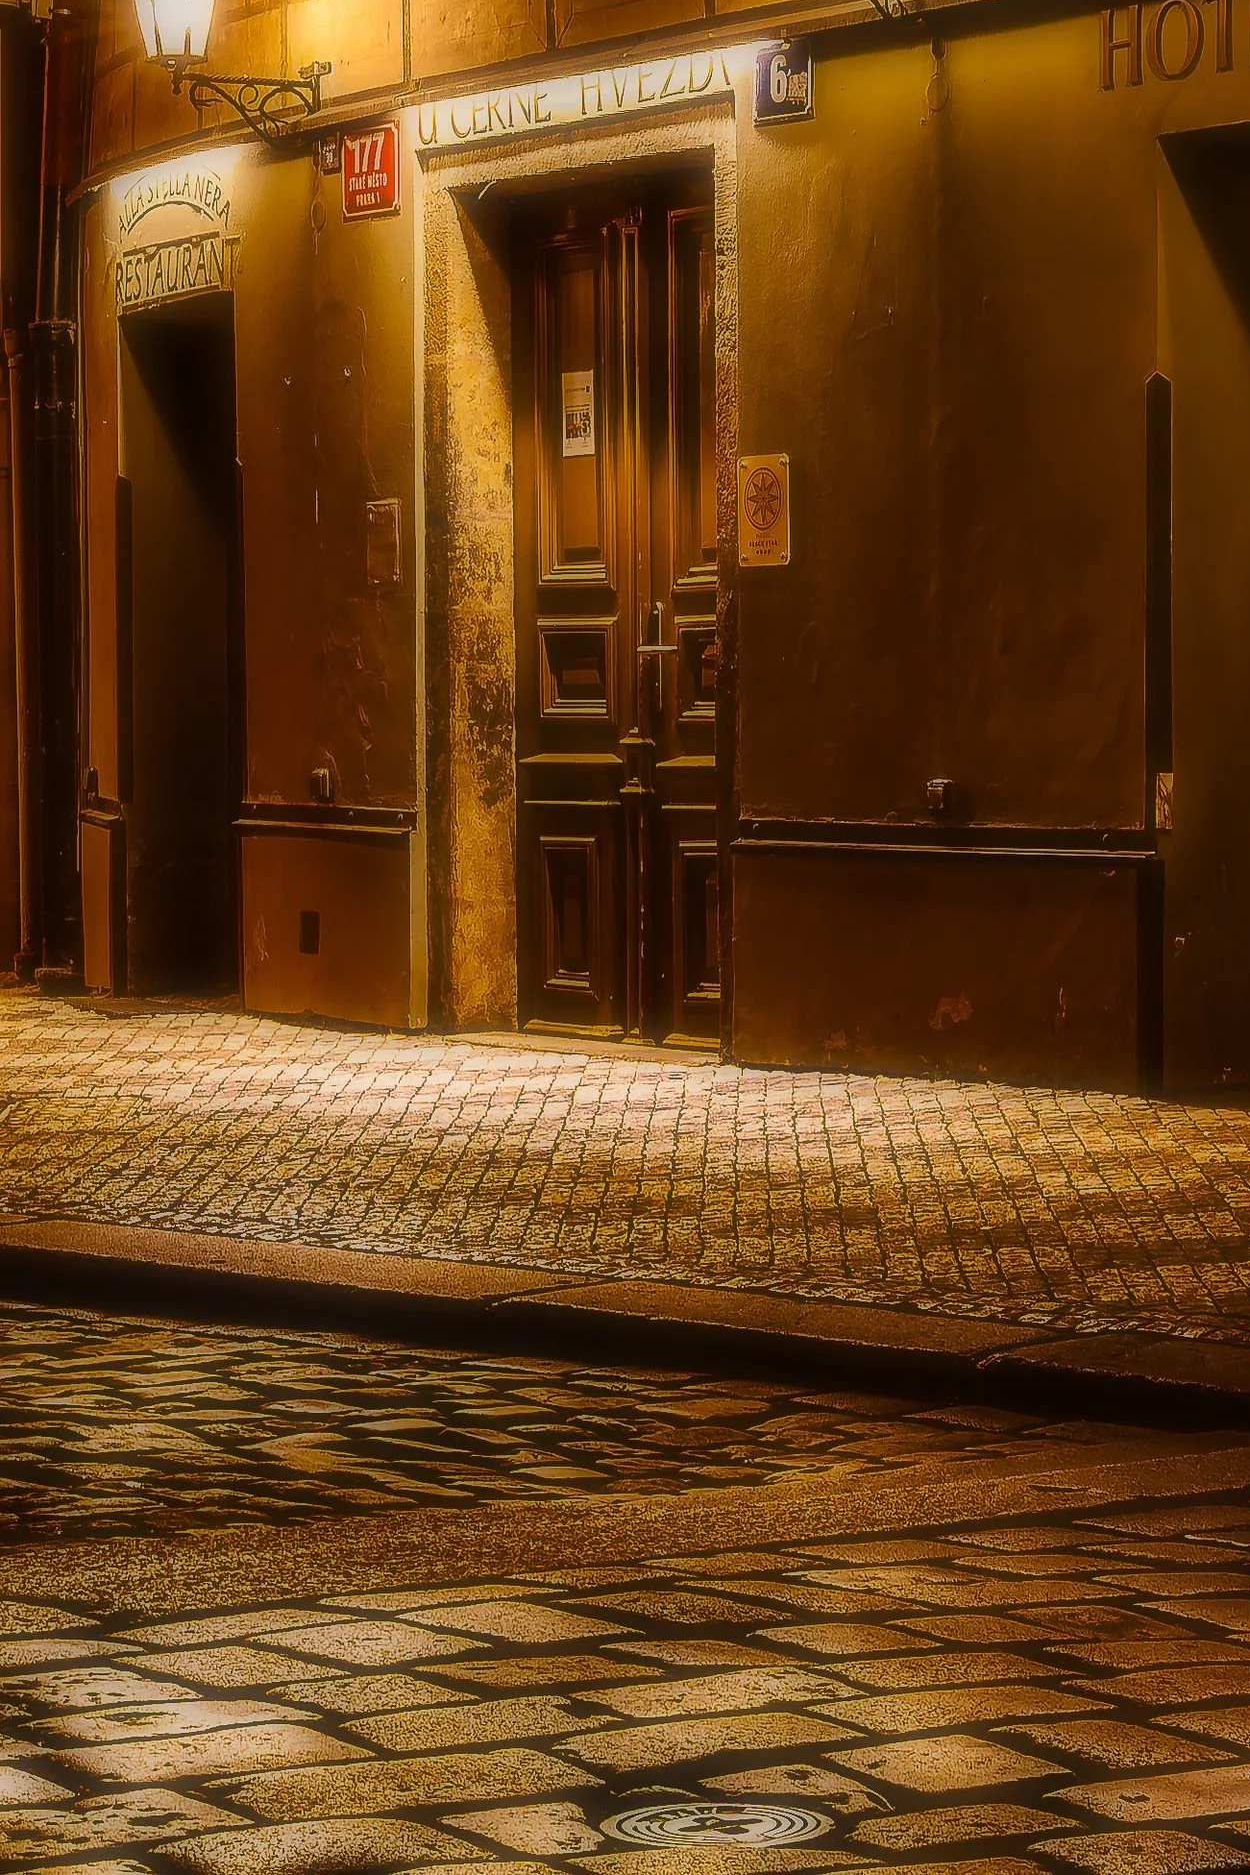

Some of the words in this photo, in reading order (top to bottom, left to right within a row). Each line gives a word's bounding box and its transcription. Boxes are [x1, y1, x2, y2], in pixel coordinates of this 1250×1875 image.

[770, 55, 787, 102] 6
[417, 104, 437, 145] U
[346, 131, 385, 173] 177
[194, 174, 231, 230] NERA
[115, 237, 241, 307] RESTAURANT
